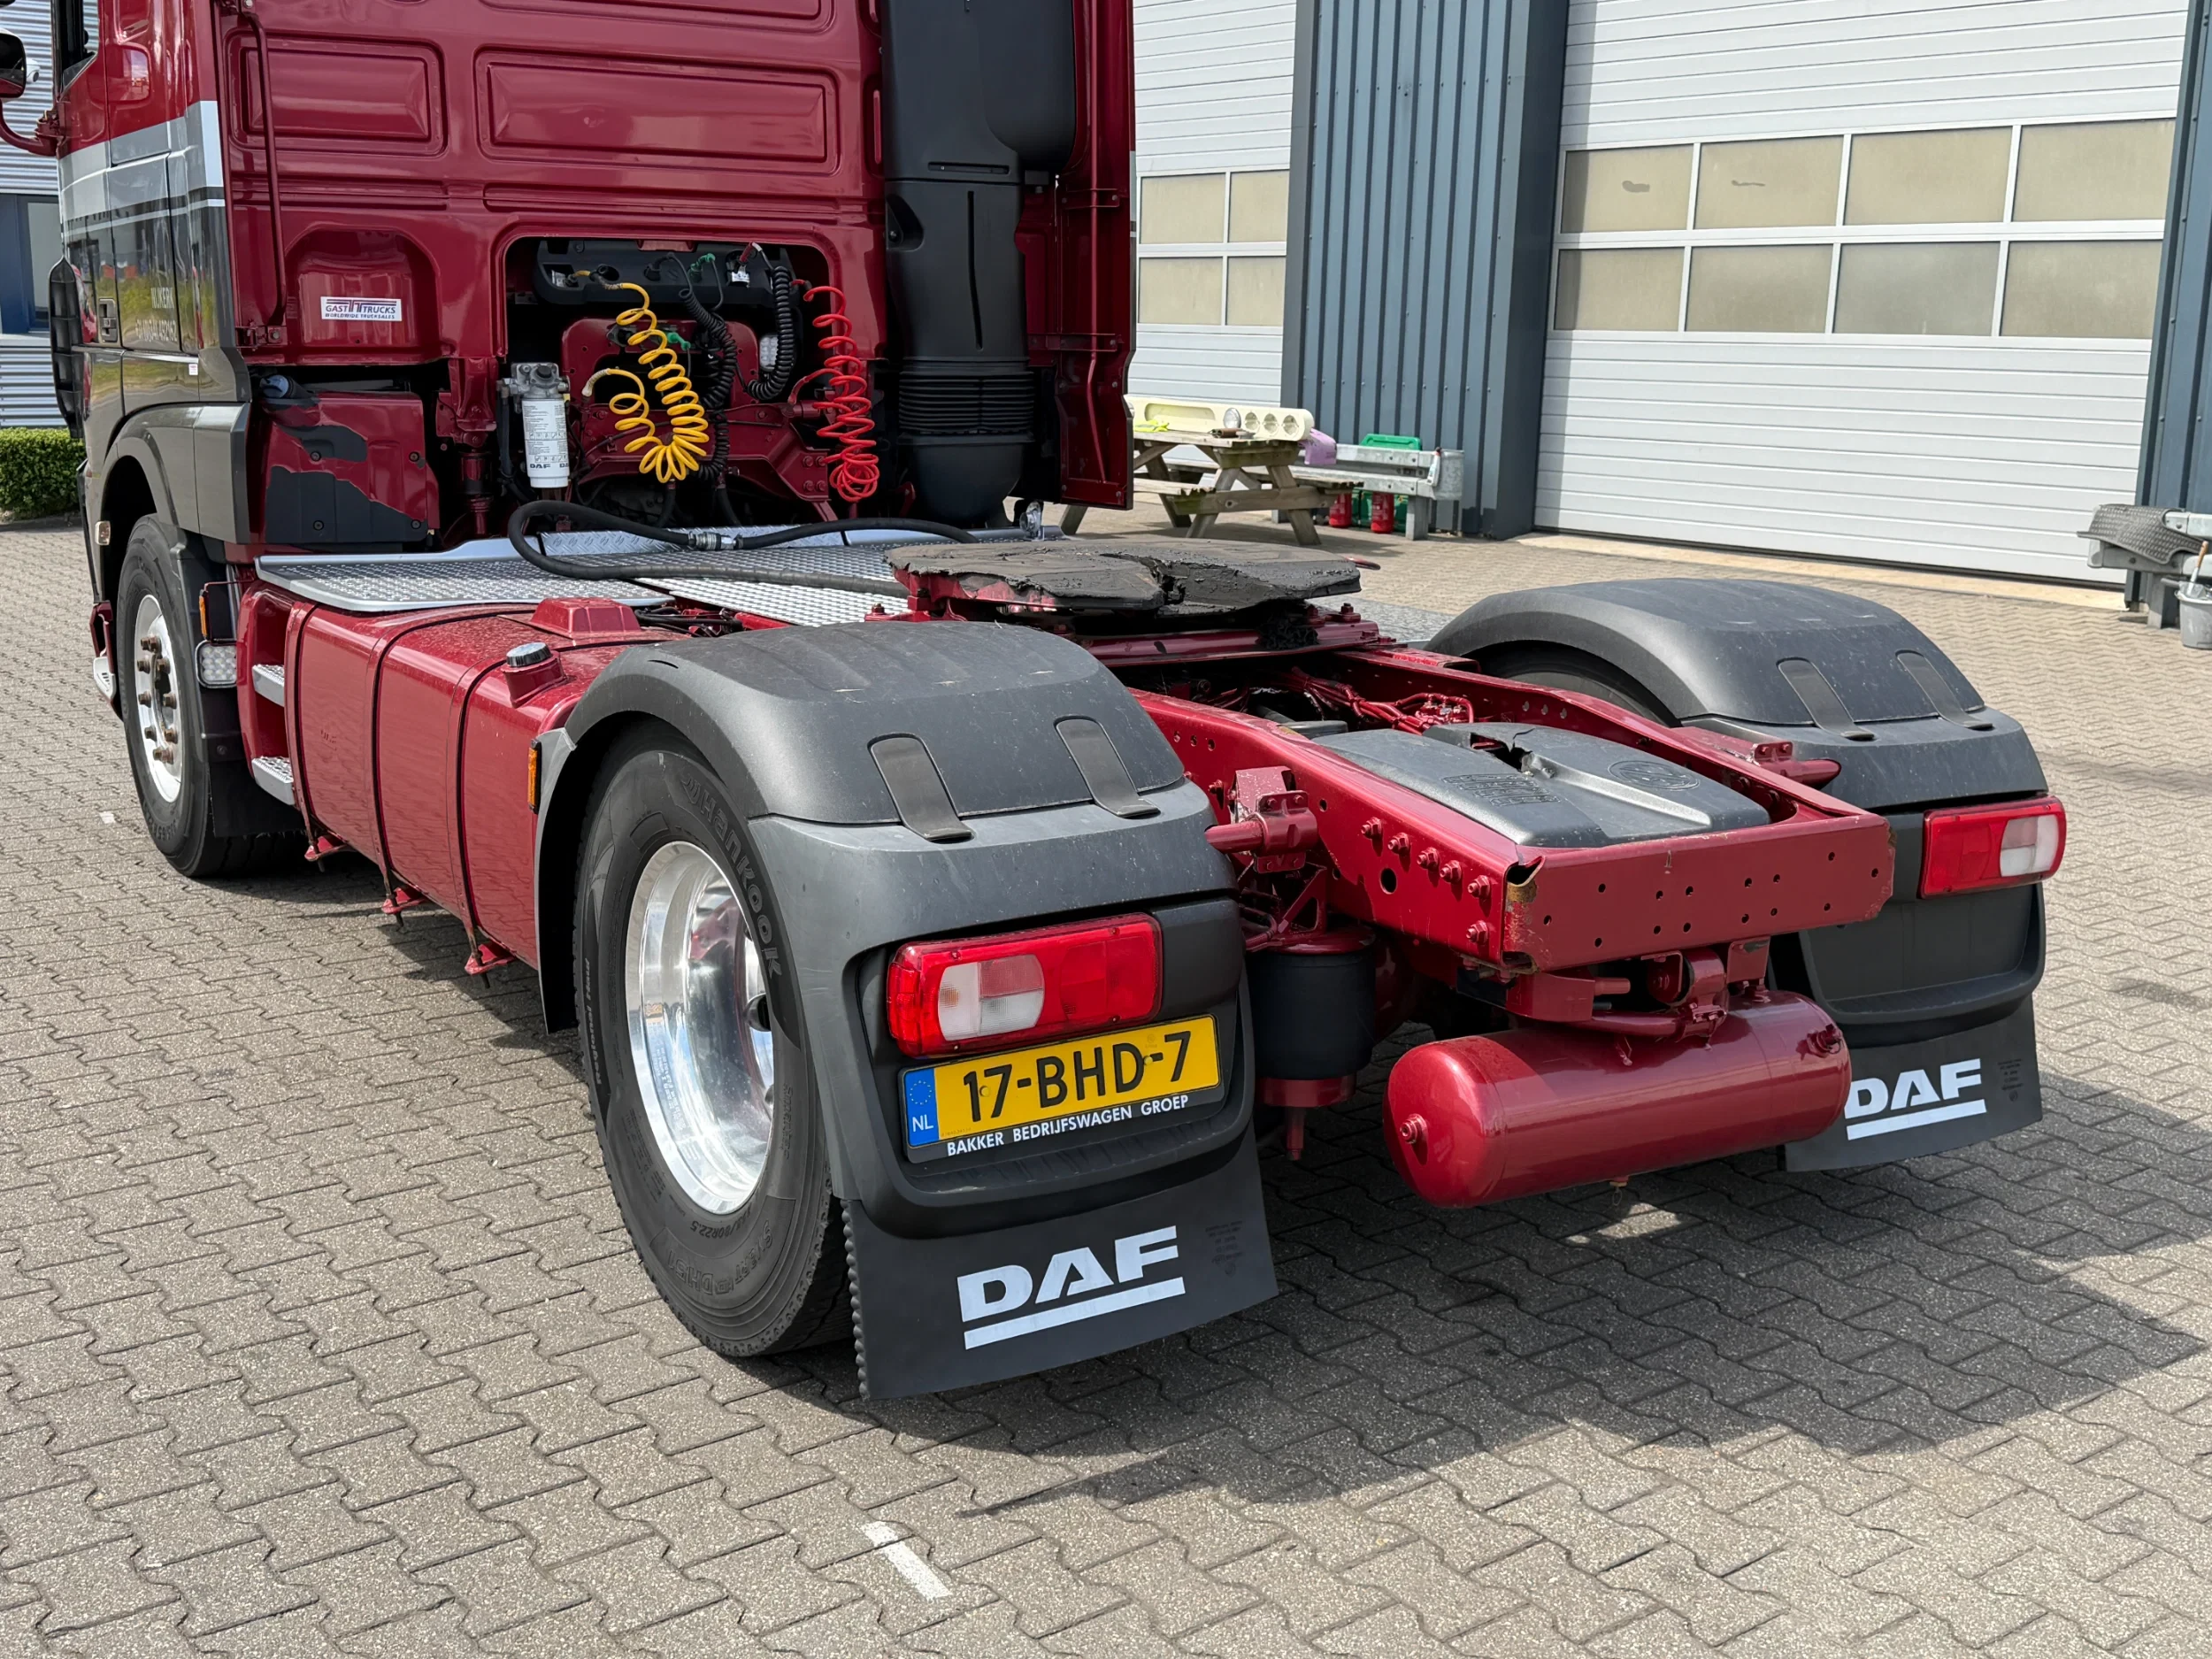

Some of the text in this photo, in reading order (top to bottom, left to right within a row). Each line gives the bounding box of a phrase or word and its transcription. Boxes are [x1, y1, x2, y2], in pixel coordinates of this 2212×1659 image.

[963, 1030, 1192, 1123] 17-BHD-7
[1844, 1057, 1982, 1120] DAF
[912, 1114, 934, 1133] NL
[947, 1131, 1004, 1156] BAKKER
[1012, 1105, 1133, 1143] BEDRIJFSWAGEN
[1141, 1094, 1189, 1117] GROEP
[956, 1225, 1179, 1323] DAF
